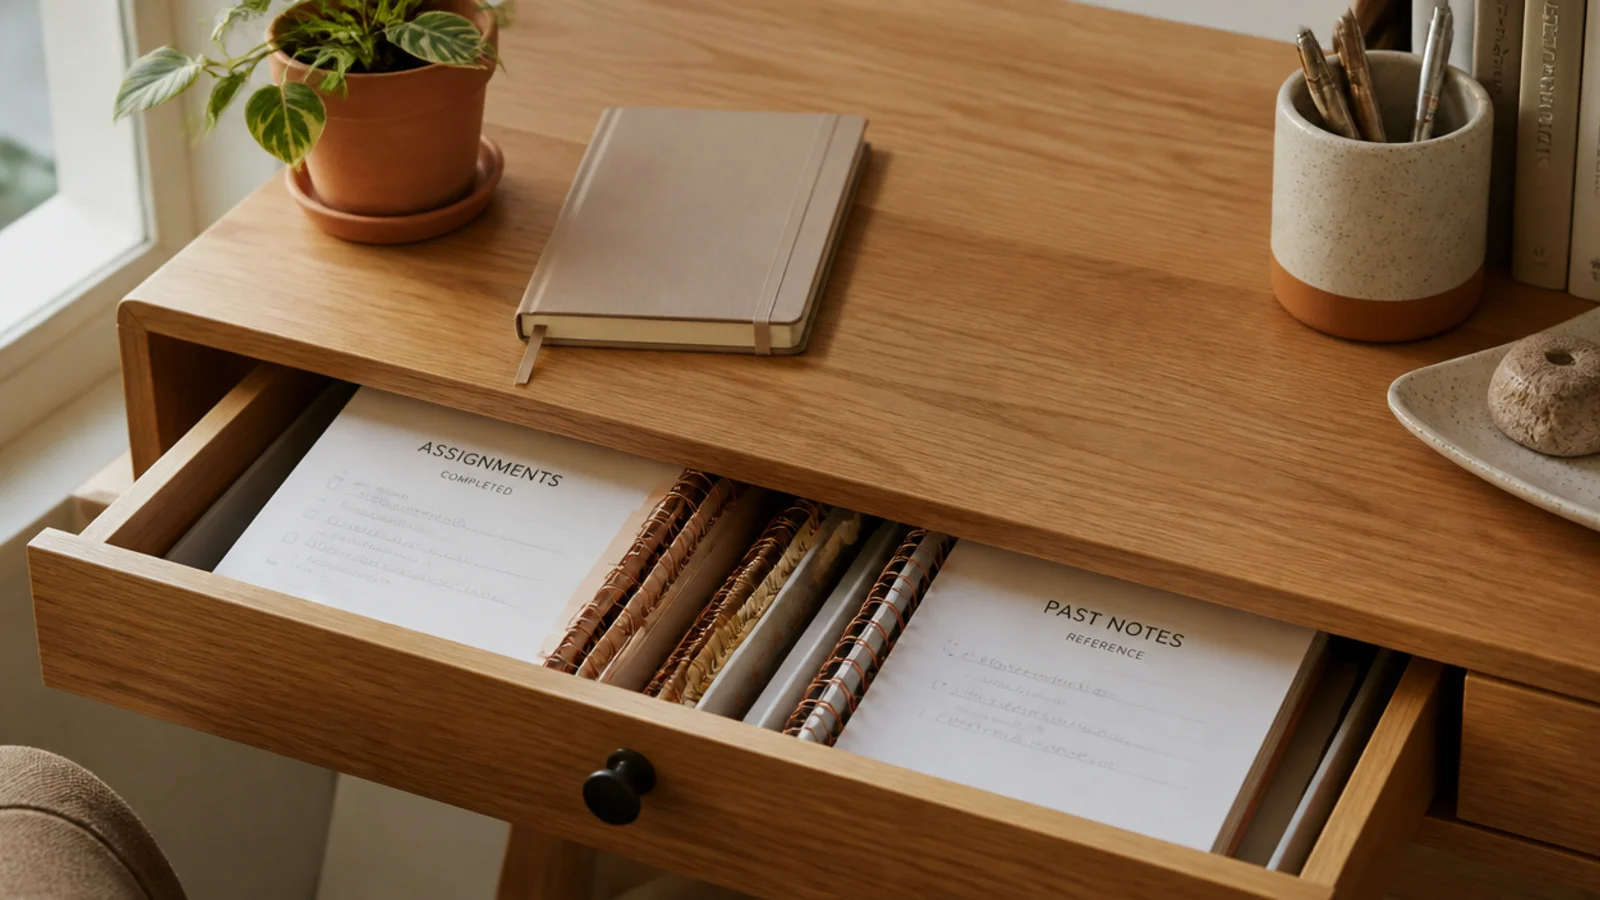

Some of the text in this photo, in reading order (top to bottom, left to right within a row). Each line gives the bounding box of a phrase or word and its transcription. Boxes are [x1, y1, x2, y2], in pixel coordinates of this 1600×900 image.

[418, 441, 563, 487] ASSIGNMENTS
[441, 470, 513, 496] COMPLETED
[1044, 599, 1185, 648] PAST NOTES
[1066, 632, 1145, 660] REFERENCE
